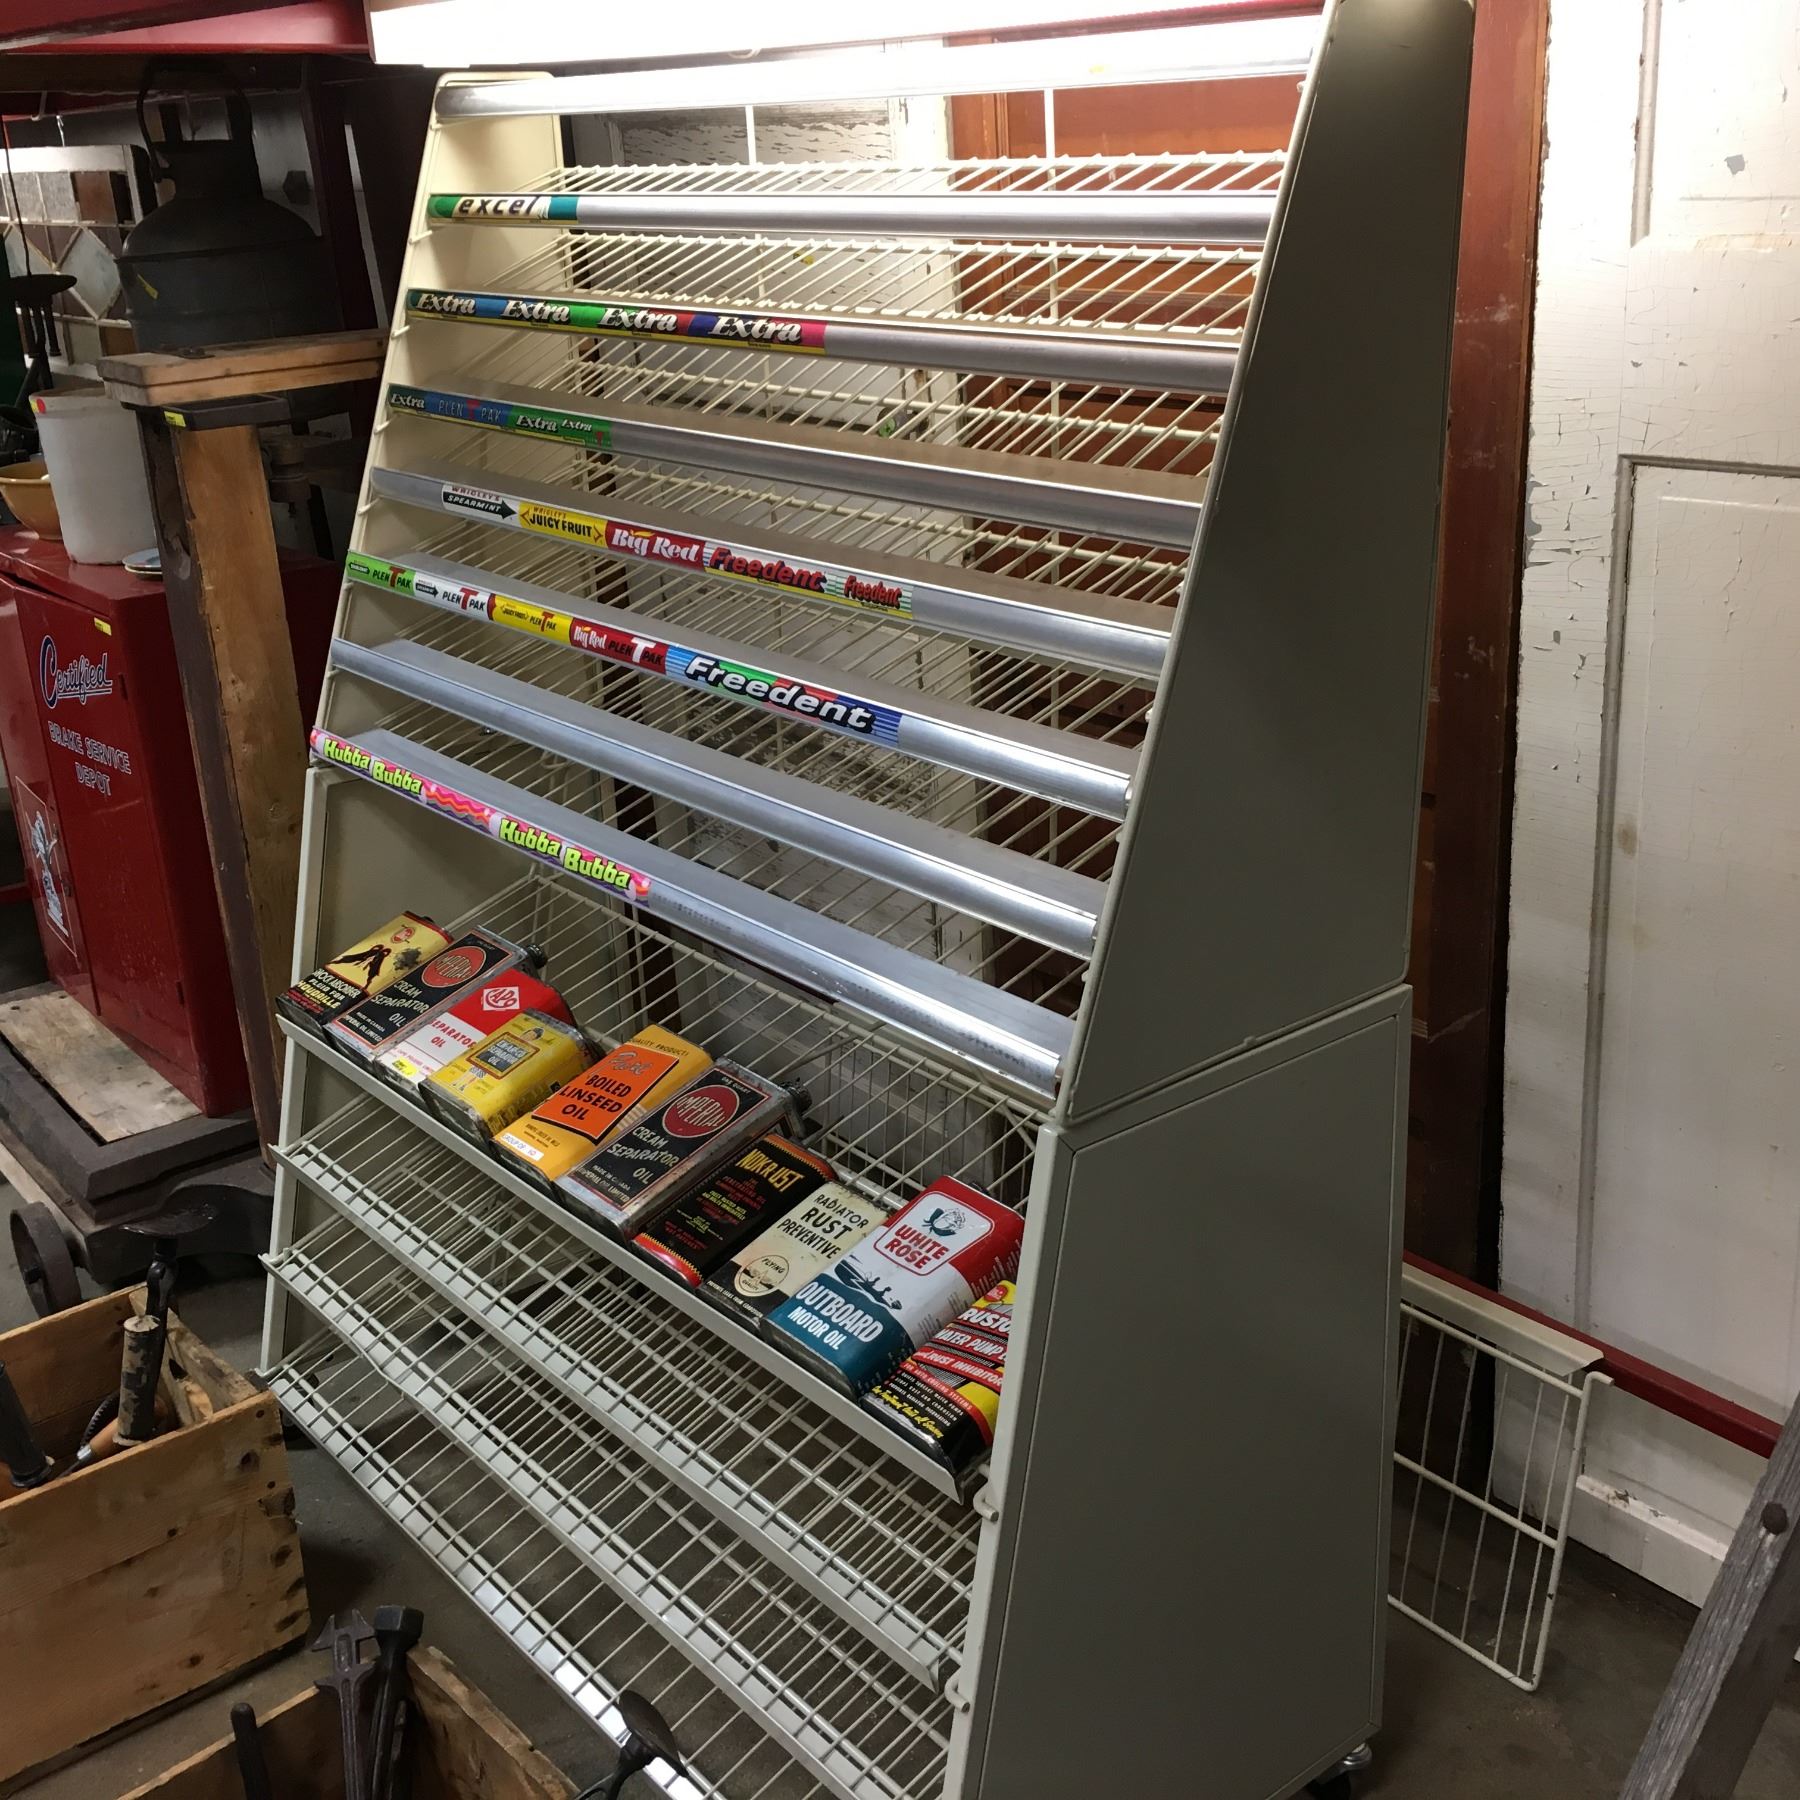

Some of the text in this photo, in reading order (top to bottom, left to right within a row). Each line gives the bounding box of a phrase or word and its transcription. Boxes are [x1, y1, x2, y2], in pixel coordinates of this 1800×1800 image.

[458, 195, 541, 216] excel
[415, 293, 476, 315] Extra
[501, 299, 570, 322] Extra
[598, 307, 678, 332] Extra
[708, 315, 801, 342] Extra
[391, 393, 425, 409] Extra
[516, 415, 558, 432] Extra
[561, 418, 592, 432] Extra
[447, 494, 501, 514] SPEARMINT
[451, 486, 500, 502] WRIGLEY'S
[529, 515, 593, 538] JUICY FRUIT
[611, 528, 700, 562] Big Red
[710, 547, 827, 591] Freedent
[843, 575, 902, 608] Freedent
[574, 625, 606, 649] Big Red
[40, 635, 113, 709] Certified
[686, 655, 875, 731] Freedent
[48, 721, 132, 774] BRAKE SERVICE
[323, 738, 422, 794] Hubba Bubba
[75, 762, 111, 796] DEPOT
[500, 817, 630, 889] Hubba Bubba
[308, 978, 330, 992] FLUID
[329, 990, 346, 1001] FOR
[394, 980, 422, 998] CREAM
[371, 994, 430, 1014] SEPARATOR
[388, 1012, 407, 1027] OIL
[431, 1036, 446, 1048] OIL
[585, 1074, 632, 1097] BOILED
[559, 1086, 623, 1114] LINSEED
[562, 1104, 590, 1121] OIL
[632, 1126, 669, 1149] CREAM
[606, 1143, 680, 1168] SEPARATOR
[632, 1167, 654, 1185] OIL
[800, 1207, 852, 1240] RUST
[814, 1194, 870, 1229] RADIATOR
[777, 1218, 842, 1259] PREVENTIVE
[893, 1224, 950, 1260] WHITE
[761, 1257, 786, 1275] FLYING
[884, 1239, 932, 1270] ROSE
[795, 1281, 884, 1343] OUTBOARD
[787, 1306, 848, 1351] MOTOR OIL
[934, 1328, 1004, 1356] WATER PUMP
[928, 1351, 955, 1365] RUST
[914, 1369, 928, 1380] AUTO
[927, 1377, 949, 1393] COOLING
[949, 1391, 973, 1411] SYSTEMS
